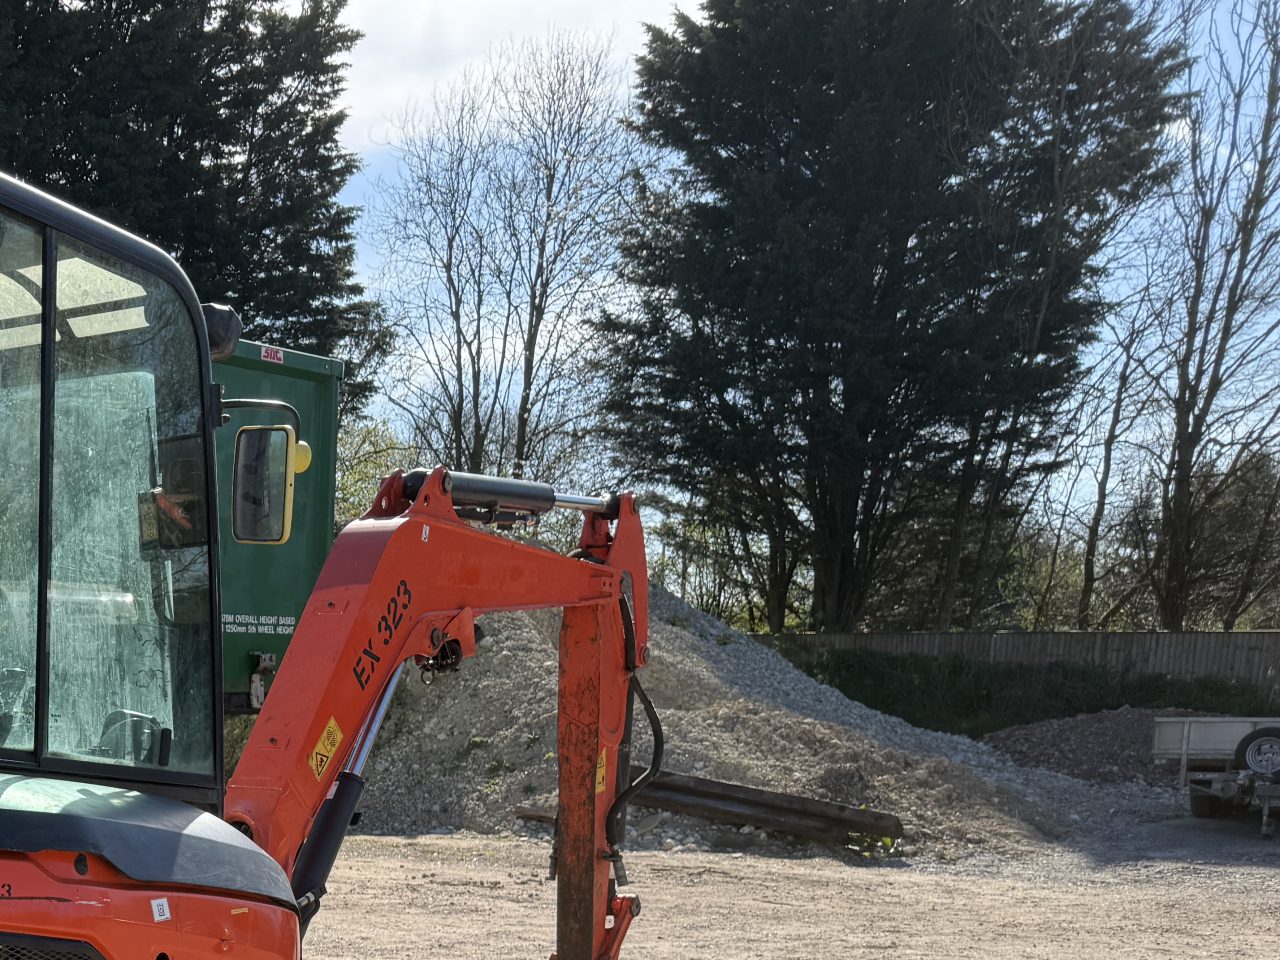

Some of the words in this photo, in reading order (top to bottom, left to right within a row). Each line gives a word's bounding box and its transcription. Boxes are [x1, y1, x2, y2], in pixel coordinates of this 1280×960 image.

[235, 614, 258, 624] OVERALL
[259, 615, 278, 625] HEIGHT
[279, 616, 296, 625] BASED
[225, 624, 247, 633] 1250mm
[257, 625, 275, 634] WHEEL
[276, 626, 295, 635] HEIGHT
[352, 637, 381, 691] EX
[377, 579, 412, 646] 323
